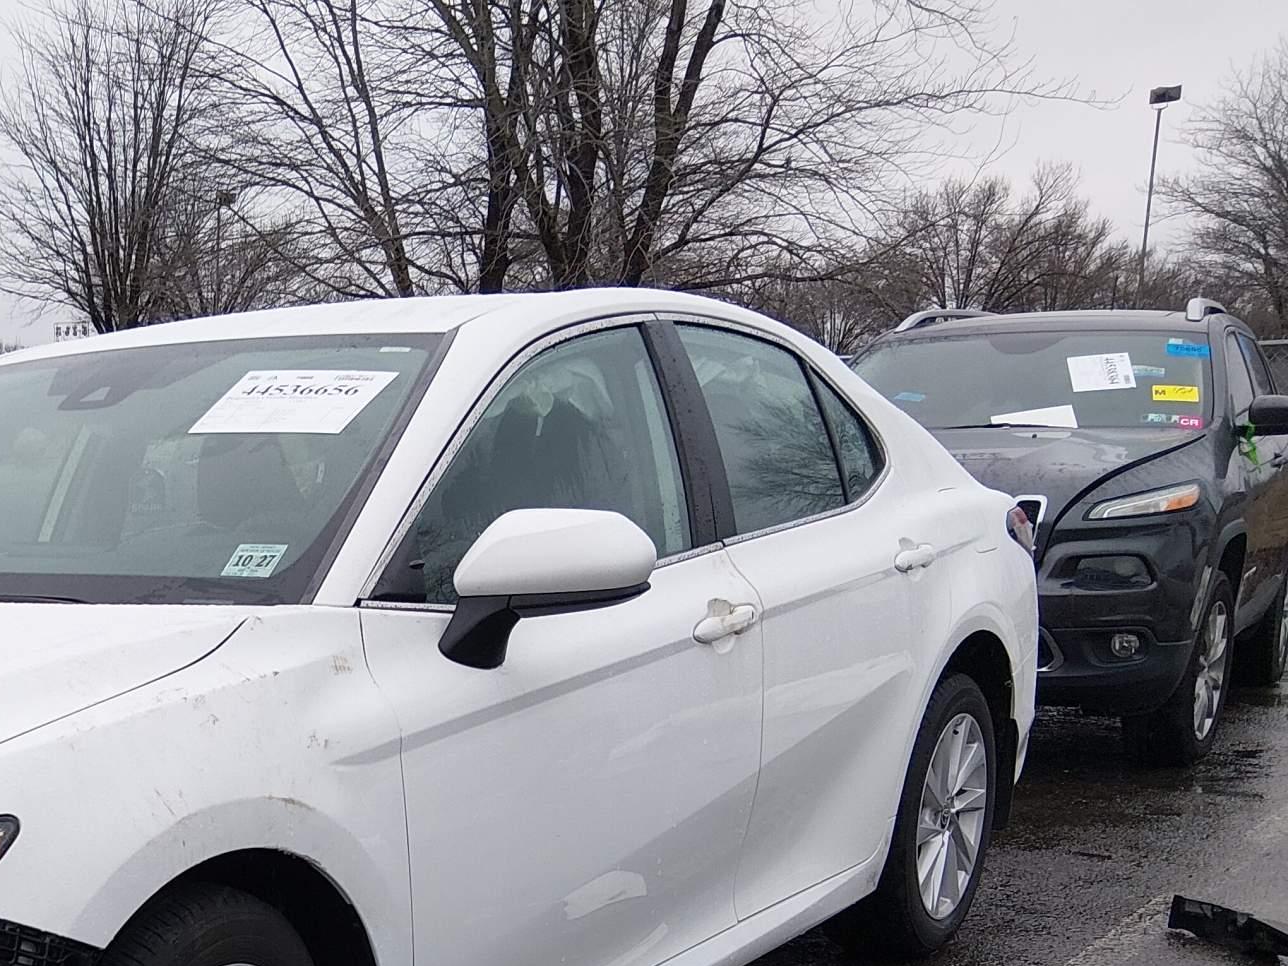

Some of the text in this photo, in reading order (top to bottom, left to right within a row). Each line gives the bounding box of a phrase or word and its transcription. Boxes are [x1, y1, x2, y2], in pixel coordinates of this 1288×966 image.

[242, 384, 360, 396] 44536656
[232, 554, 278, 567] 10 27
